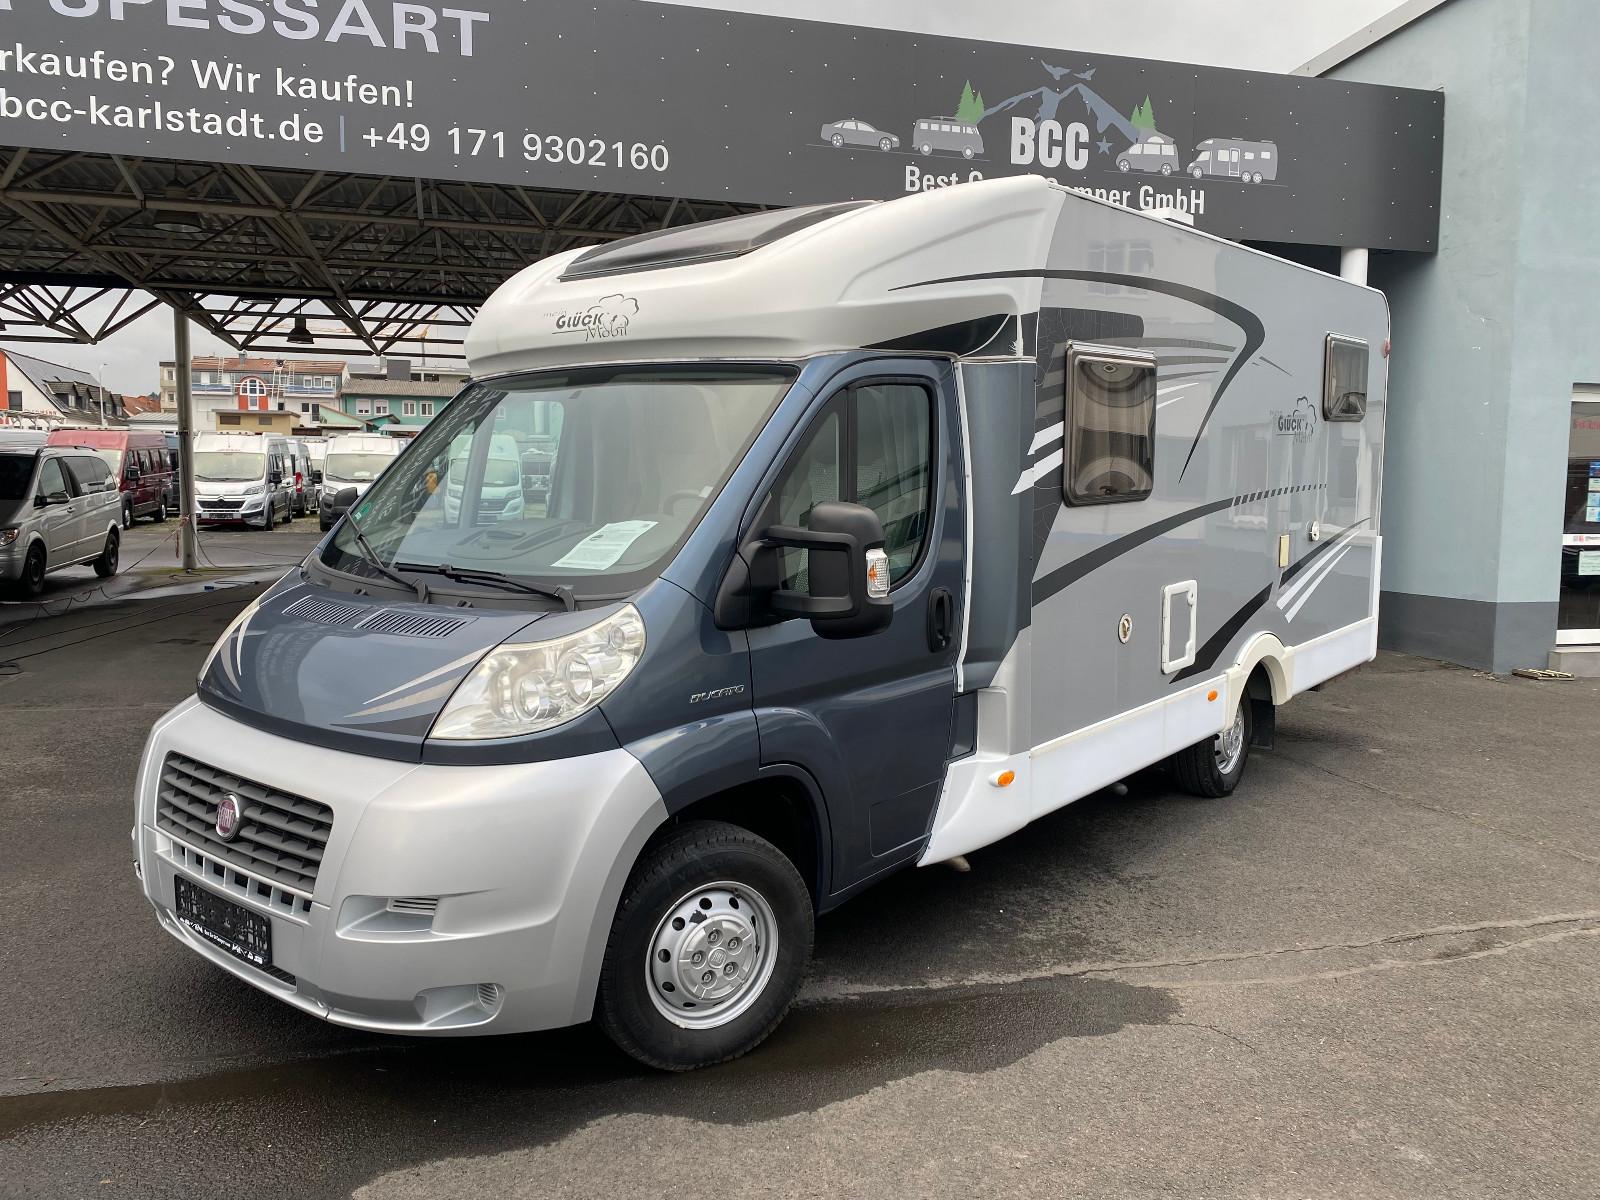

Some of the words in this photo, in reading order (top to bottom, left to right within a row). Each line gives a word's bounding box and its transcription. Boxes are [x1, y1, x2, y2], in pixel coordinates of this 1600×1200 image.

[190, 59, 260, 93] Wir
[276, 67, 413, 108] kaufen!
[0, 87, 324, 143] bcc-karlstadt.de
[362, 122, 431, 151] +49
[448, 127, 504, 158] 171
[522, 133, 669, 172] 9302160
[1010, 116, 1089, 171] BCC
[1139, 185, 1205, 214] GmbH
